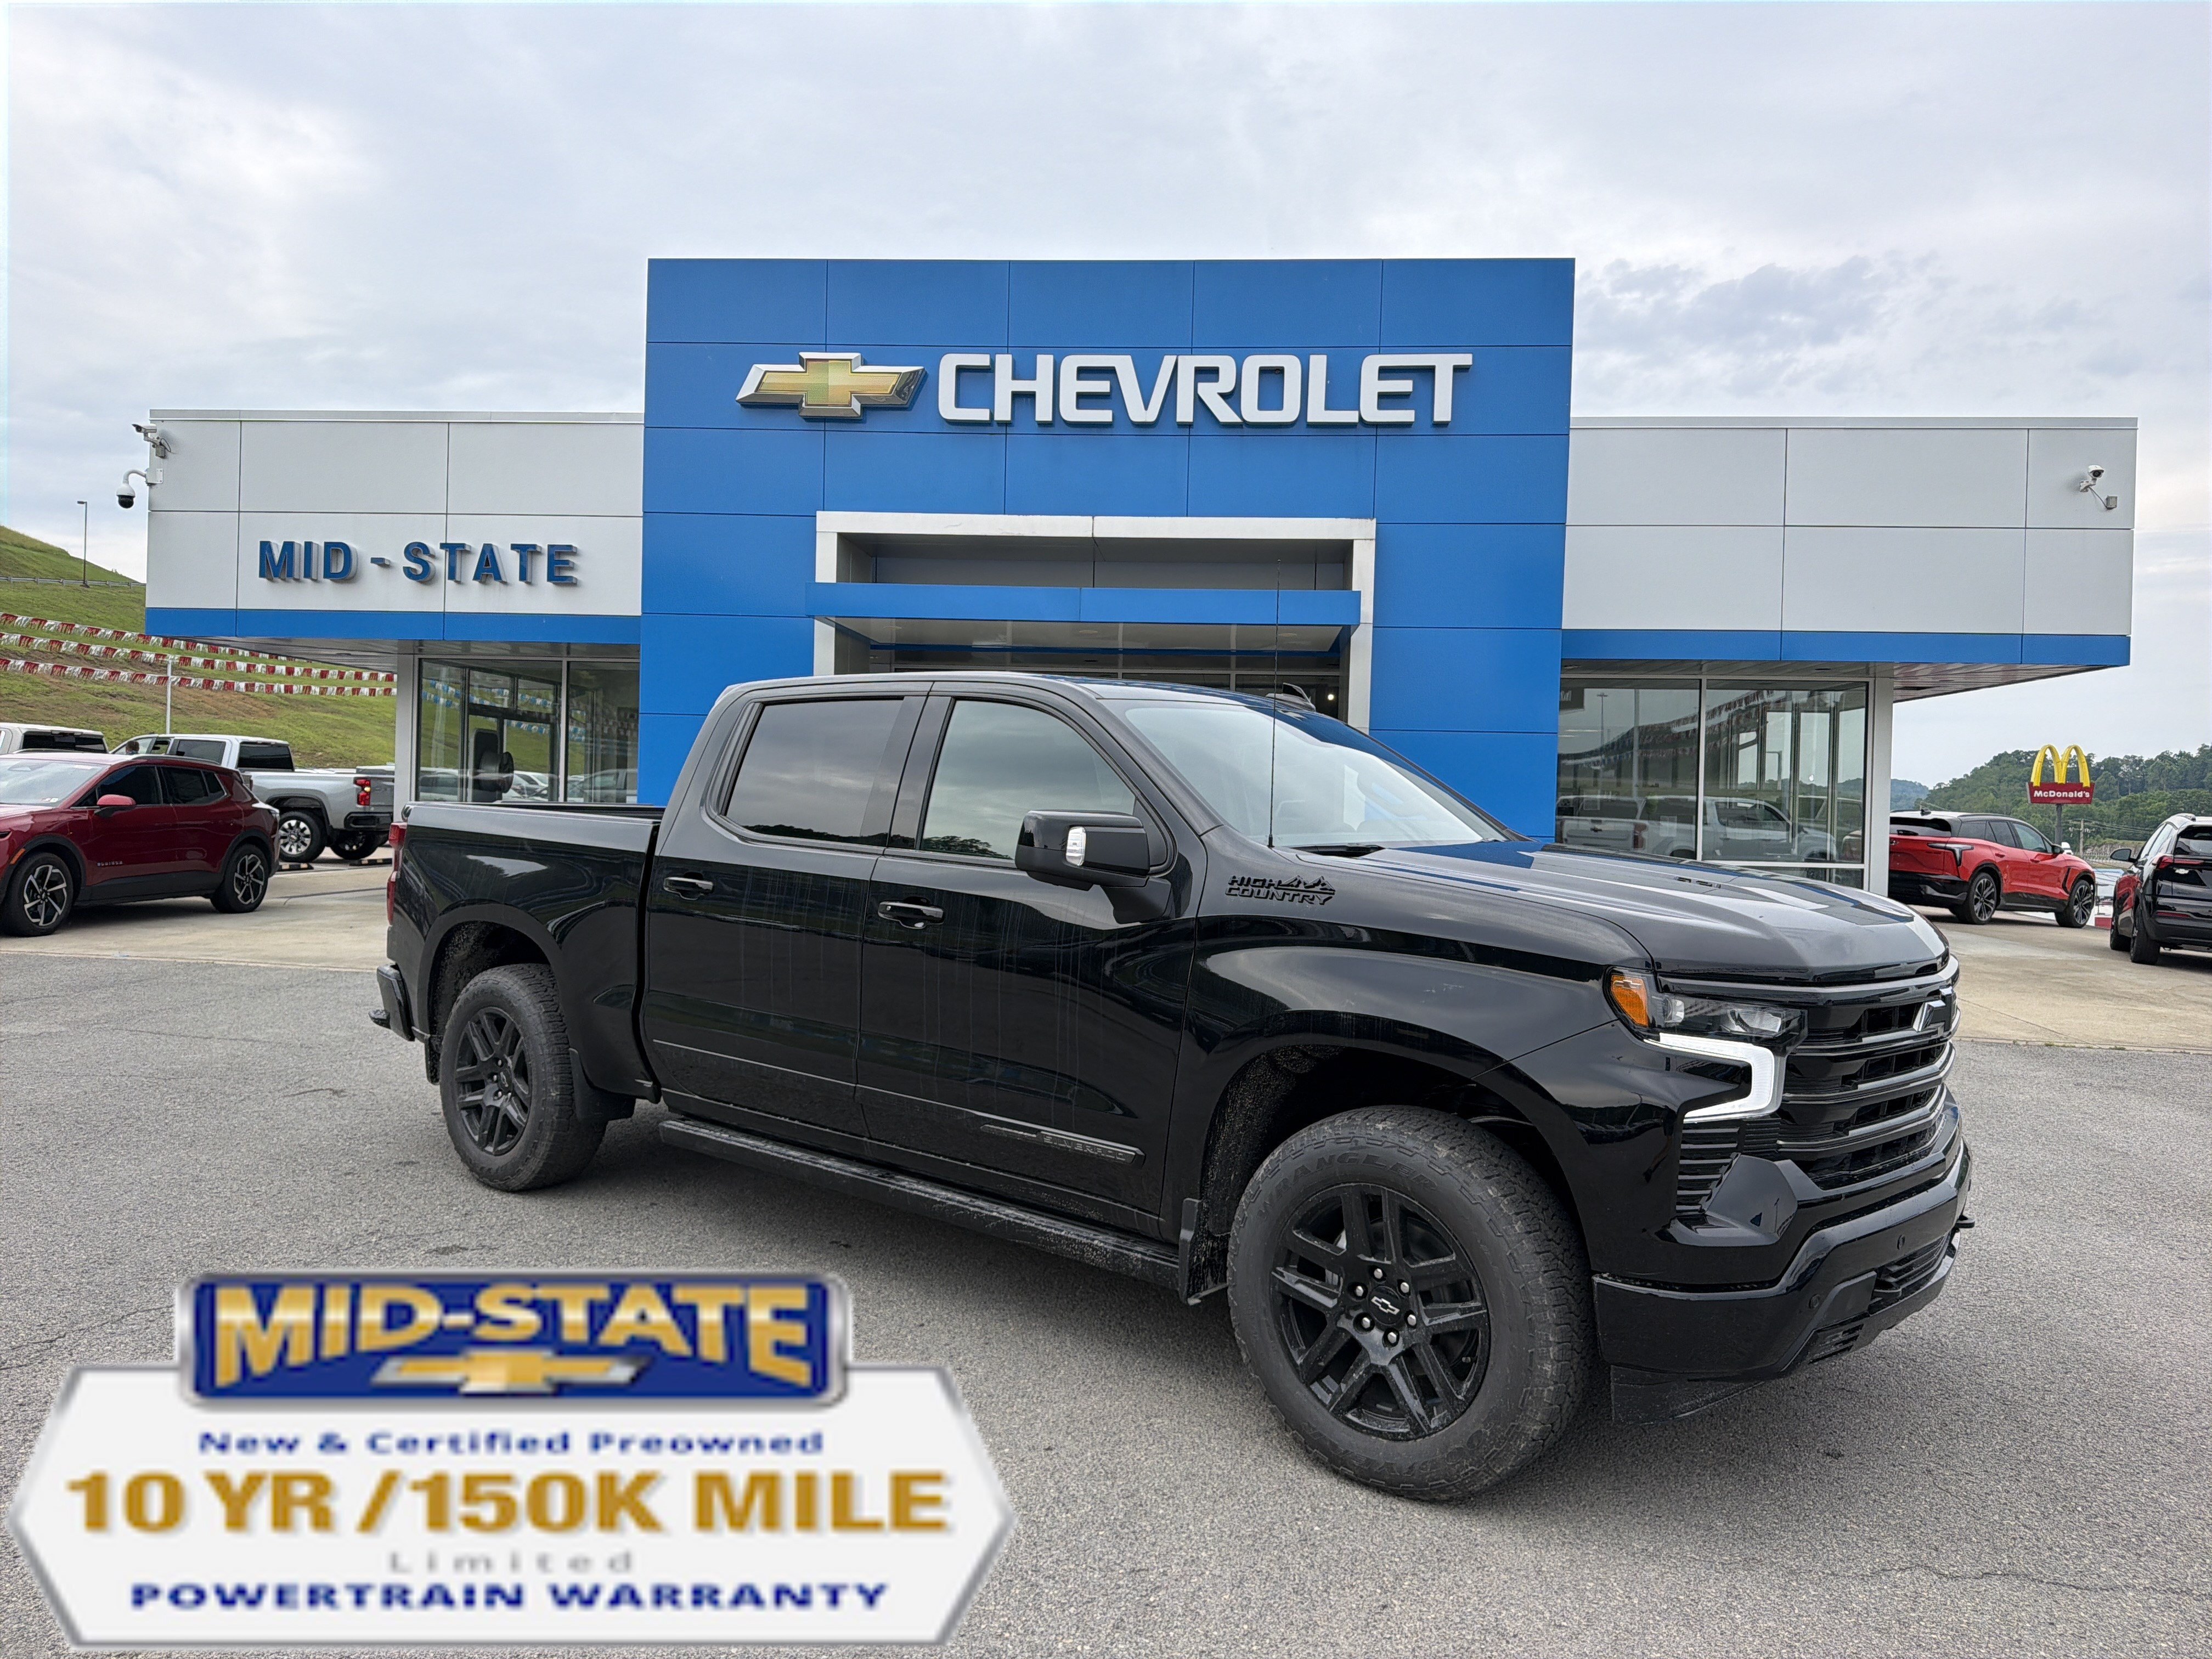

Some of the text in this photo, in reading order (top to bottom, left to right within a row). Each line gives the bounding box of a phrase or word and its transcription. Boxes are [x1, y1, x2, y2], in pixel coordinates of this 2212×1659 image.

[938, 353, 1474, 425] CHEVROLET
[1228, 875, 1282, 889] HIGH
[1225, 887, 1333, 905] COUNTRY
[1043, 1135, 1126, 1161] SILVERADO
